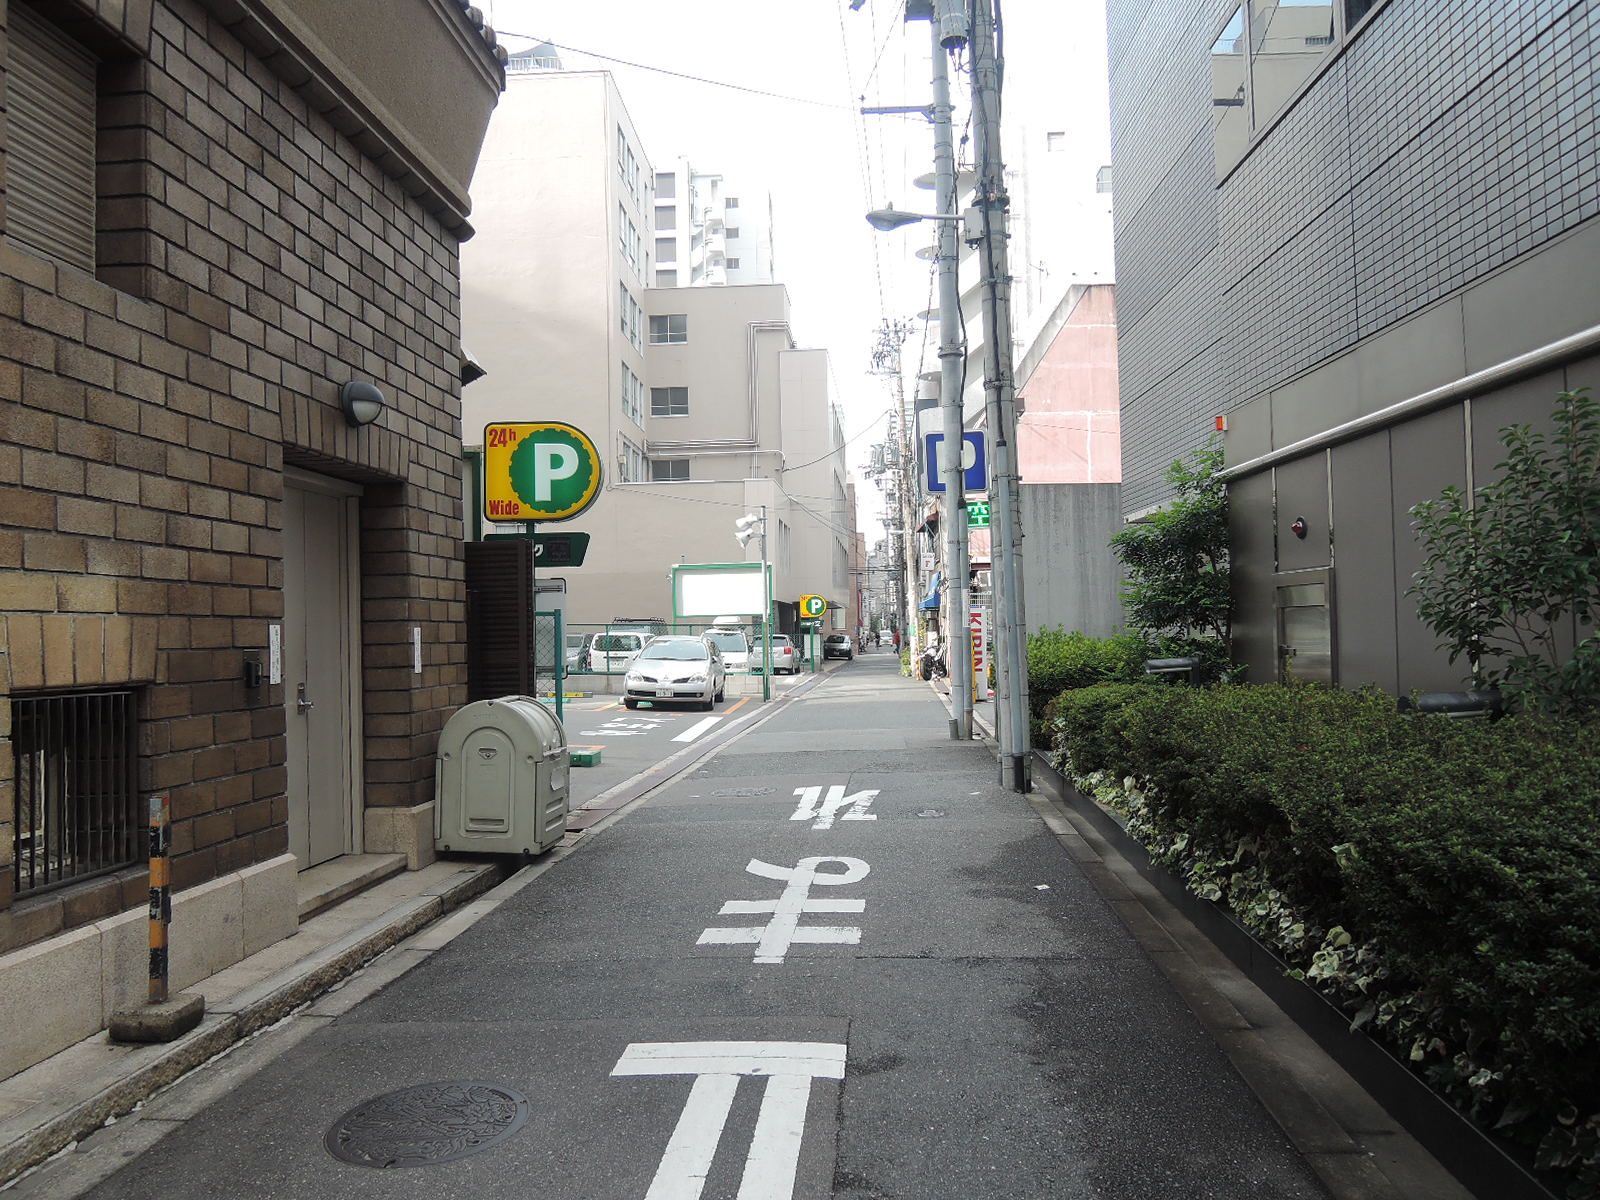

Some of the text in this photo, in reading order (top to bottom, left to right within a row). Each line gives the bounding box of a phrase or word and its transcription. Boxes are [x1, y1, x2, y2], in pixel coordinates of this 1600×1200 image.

[534, 443, 579, 502] P
[488, 500, 520, 516] Wide
[811, 598, 823, 614] P
